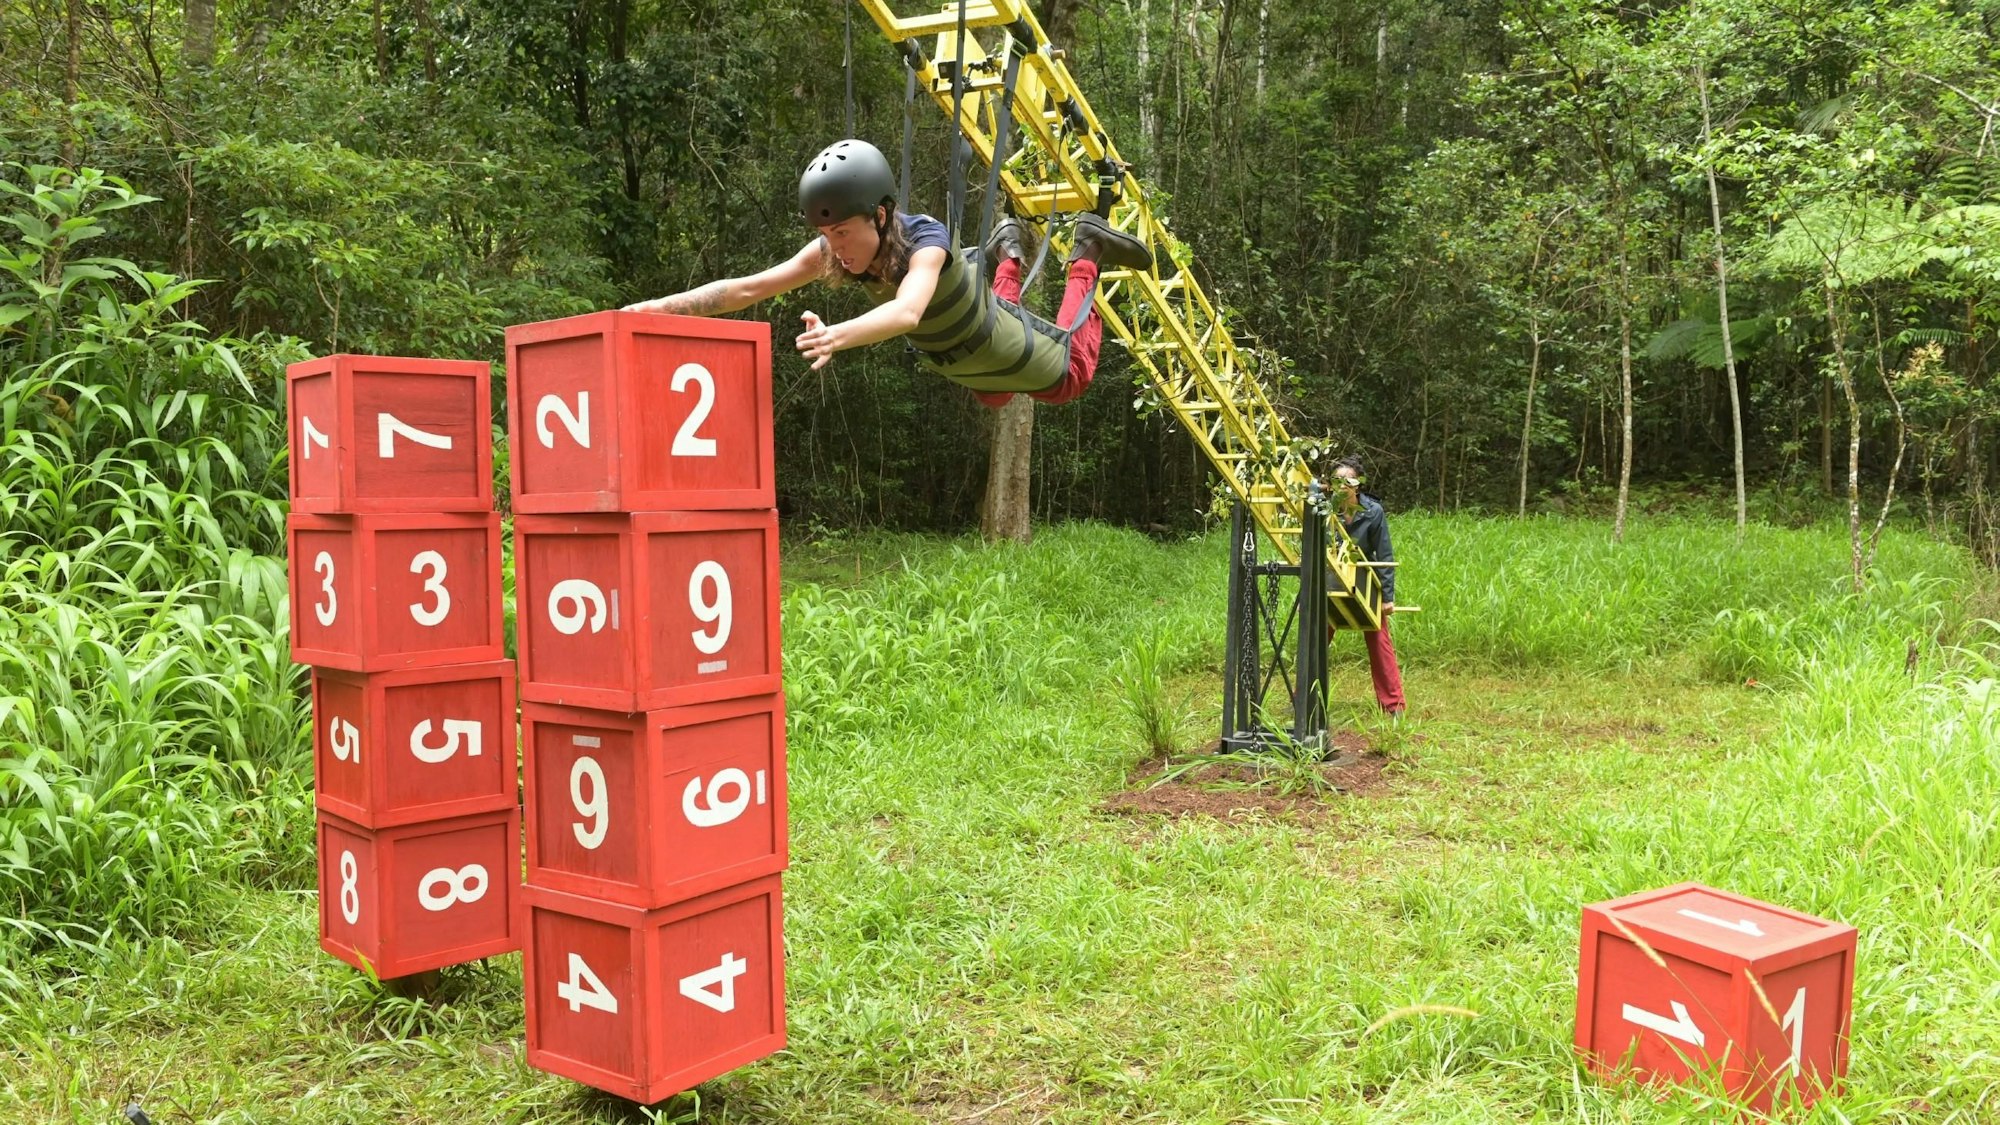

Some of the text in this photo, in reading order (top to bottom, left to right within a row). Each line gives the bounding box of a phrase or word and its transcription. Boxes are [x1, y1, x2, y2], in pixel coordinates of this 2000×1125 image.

[303, 416, 329, 460] 7
[378, 413, 452, 458] 7
[536, 391, 590, 448] 2
[671, 363, 716, 456] 2
[314, 551, 337, 626] 3
[410, 550, 451, 626] 3
[689, 561, 732, 654] 9
[331, 716, 360, 764] 5
[410, 719, 481, 763] 5
[340, 850, 360, 925] 8
[418, 864, 489, 911] 8
[1677, 908, 1765, 936] 1
[557, 953, 617, 1013] 4
[680, 952, 746, 1012] 4
[1622, 1000, 1705, 1047] 1
[1782, 987, 1806, 1077] 1
